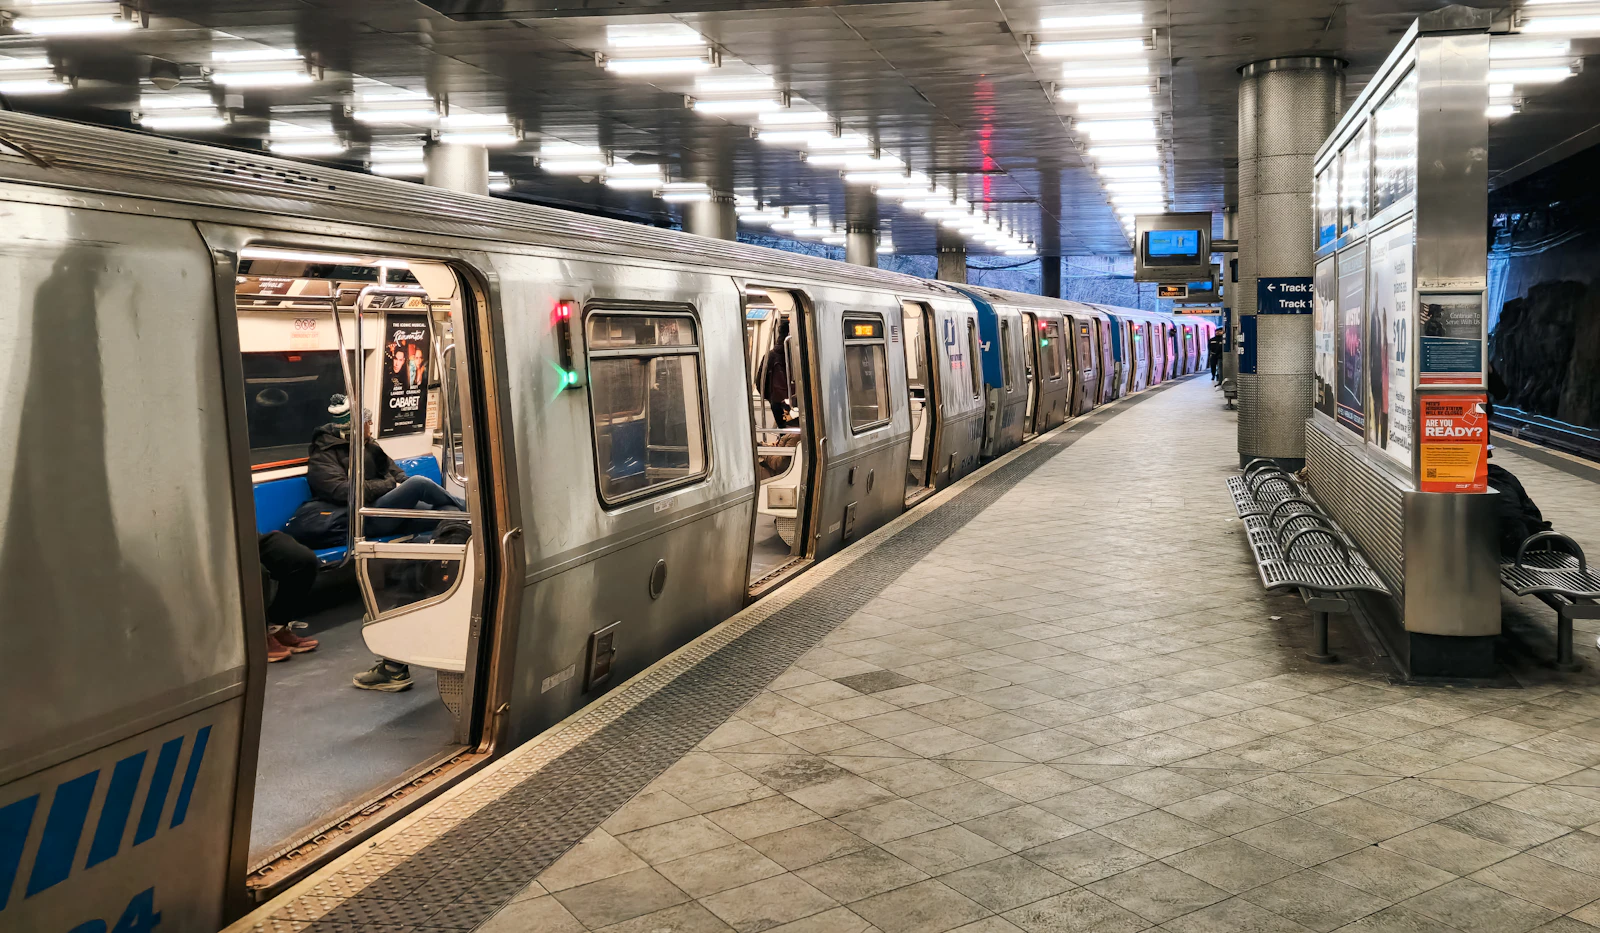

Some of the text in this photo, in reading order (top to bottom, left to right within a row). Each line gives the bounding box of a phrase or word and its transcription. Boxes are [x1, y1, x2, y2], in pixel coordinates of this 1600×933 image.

[1280, 283, 1314, 292] Track 2
[1279, 299, 1313, 308] Track 1
[1393, 317, 1406, 363] $10
[389, 395, 420, 409] CABARET
[1426, 419, 1453, 427] ARE YOU
[1425, 427, 1483, 437] READY?
